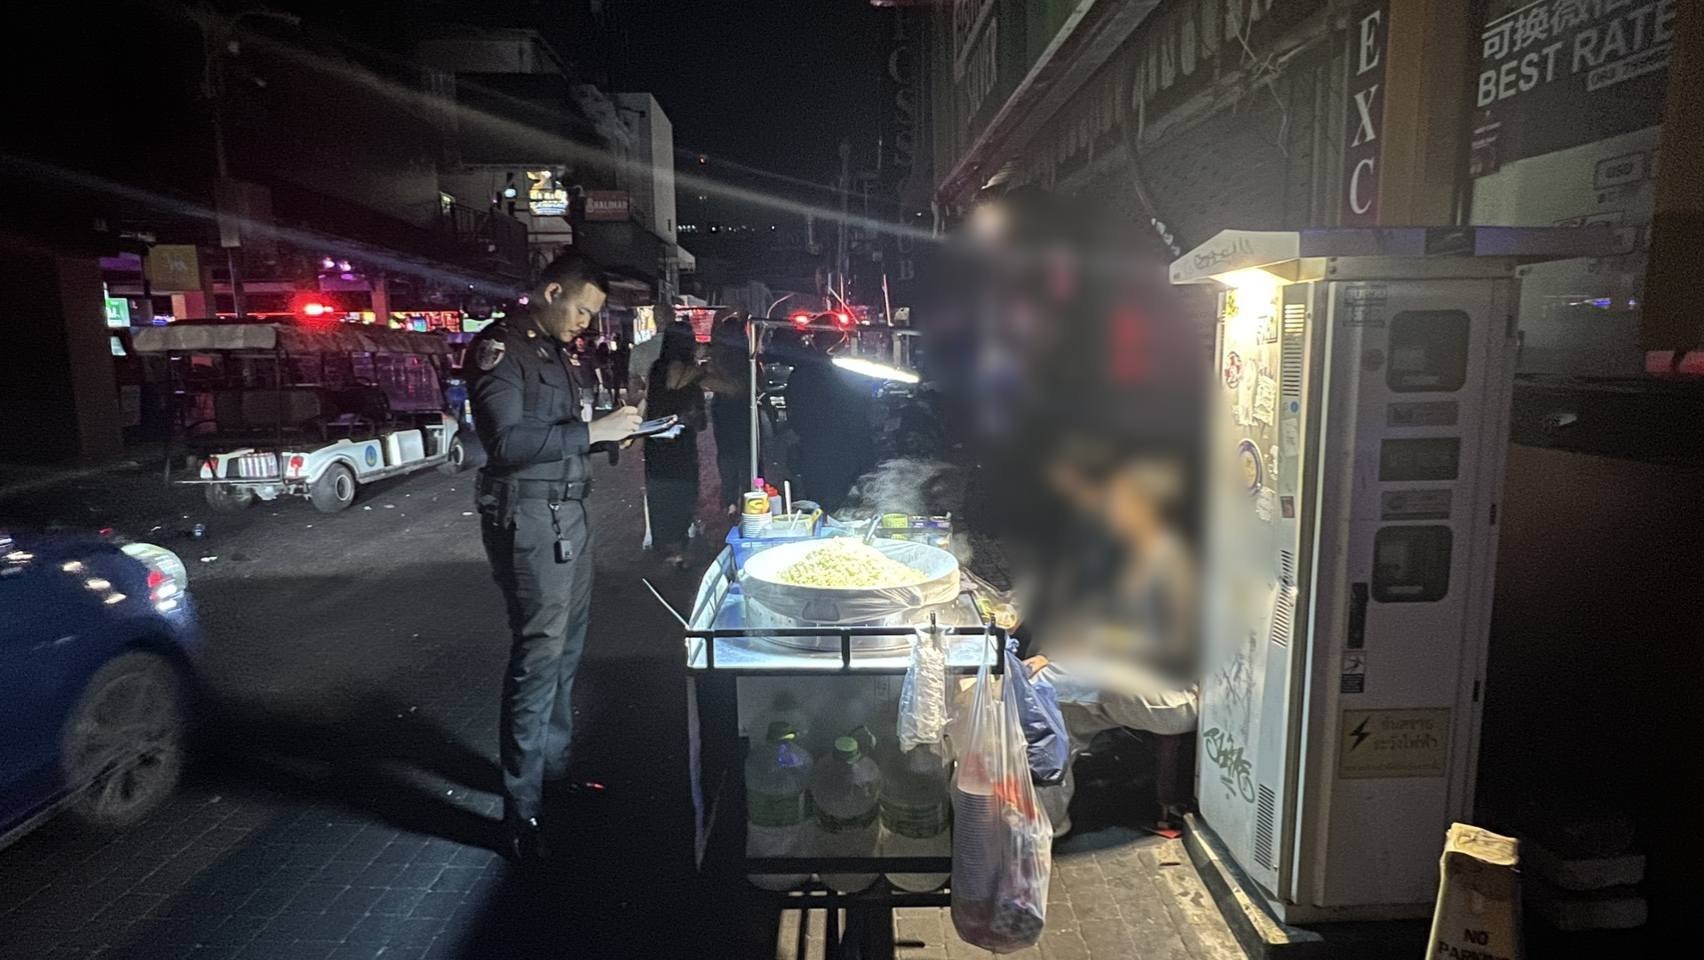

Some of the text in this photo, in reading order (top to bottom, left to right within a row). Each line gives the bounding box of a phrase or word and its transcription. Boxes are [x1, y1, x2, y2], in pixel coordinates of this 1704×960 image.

[1476, 41, 1563, 108] BEST
[1571, 0, 1676, 73] RATE
[1464, 928, 1489, 946] NO
[1438, 941, 1510, 960] PARKI
